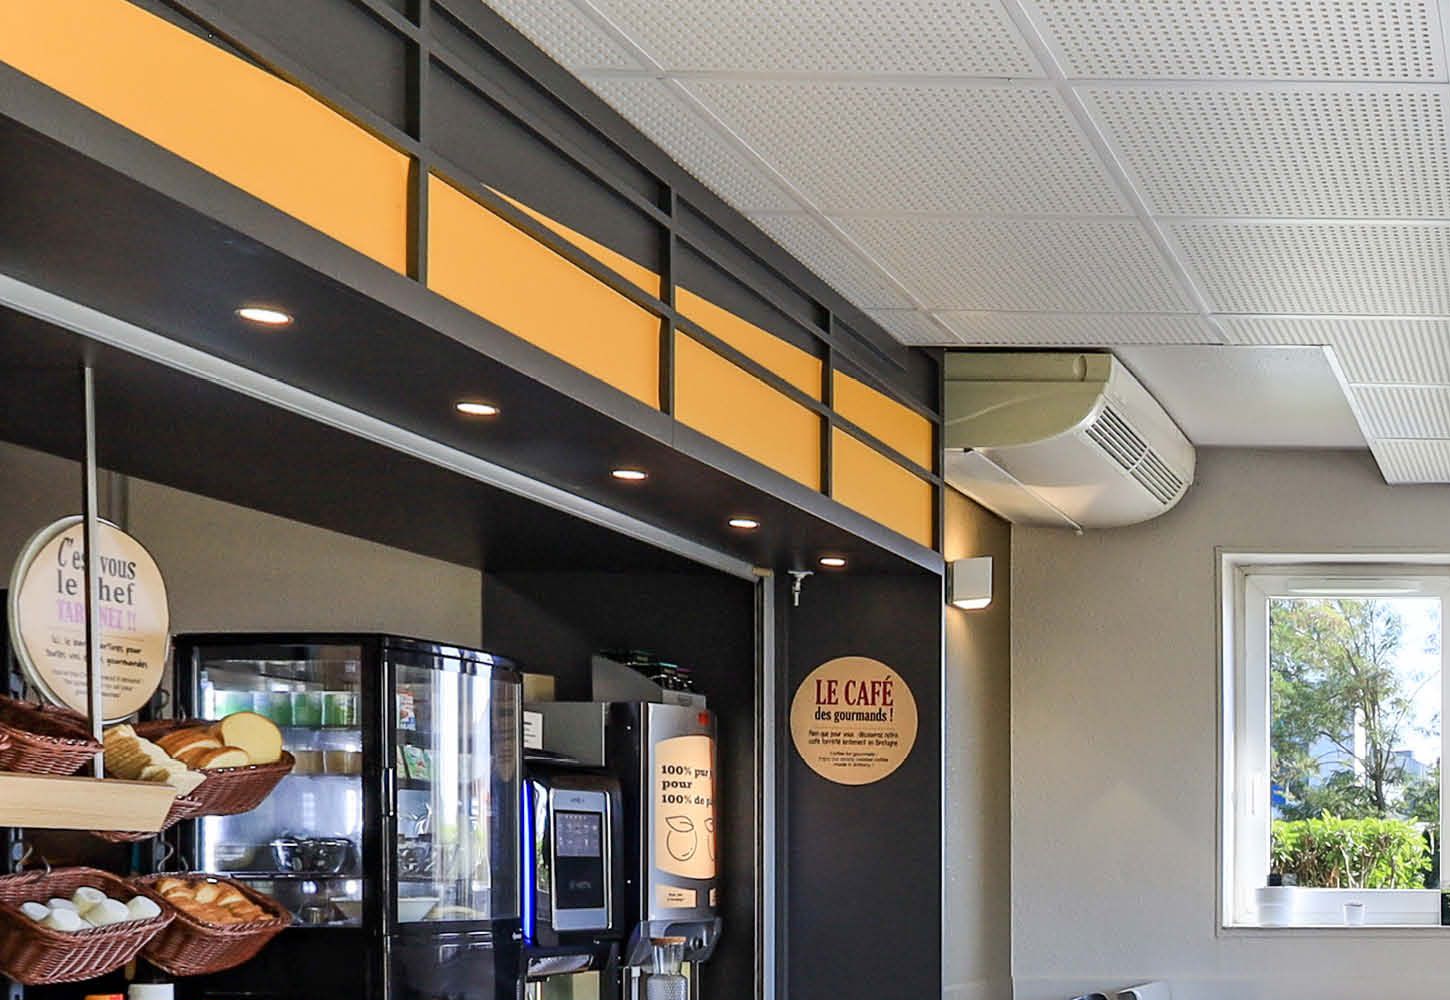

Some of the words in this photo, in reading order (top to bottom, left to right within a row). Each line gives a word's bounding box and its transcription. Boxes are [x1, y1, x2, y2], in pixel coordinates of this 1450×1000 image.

[99, 555, 136, 580] vous
[57, 568, 79, 596] le
[815, 679, 839, 705] LE
[844, 675, 894, 706] CAFÉ
[814, 706, 832, 721] des
[833, 707, 888, 723] gourmands
[889, 707, 894, 723] !
[661, 765, 692, 776] 100%
[661, 780, 693, 791] pour
[661, 794, 692, 804] 100%
[694, 795, 705, 806] de
